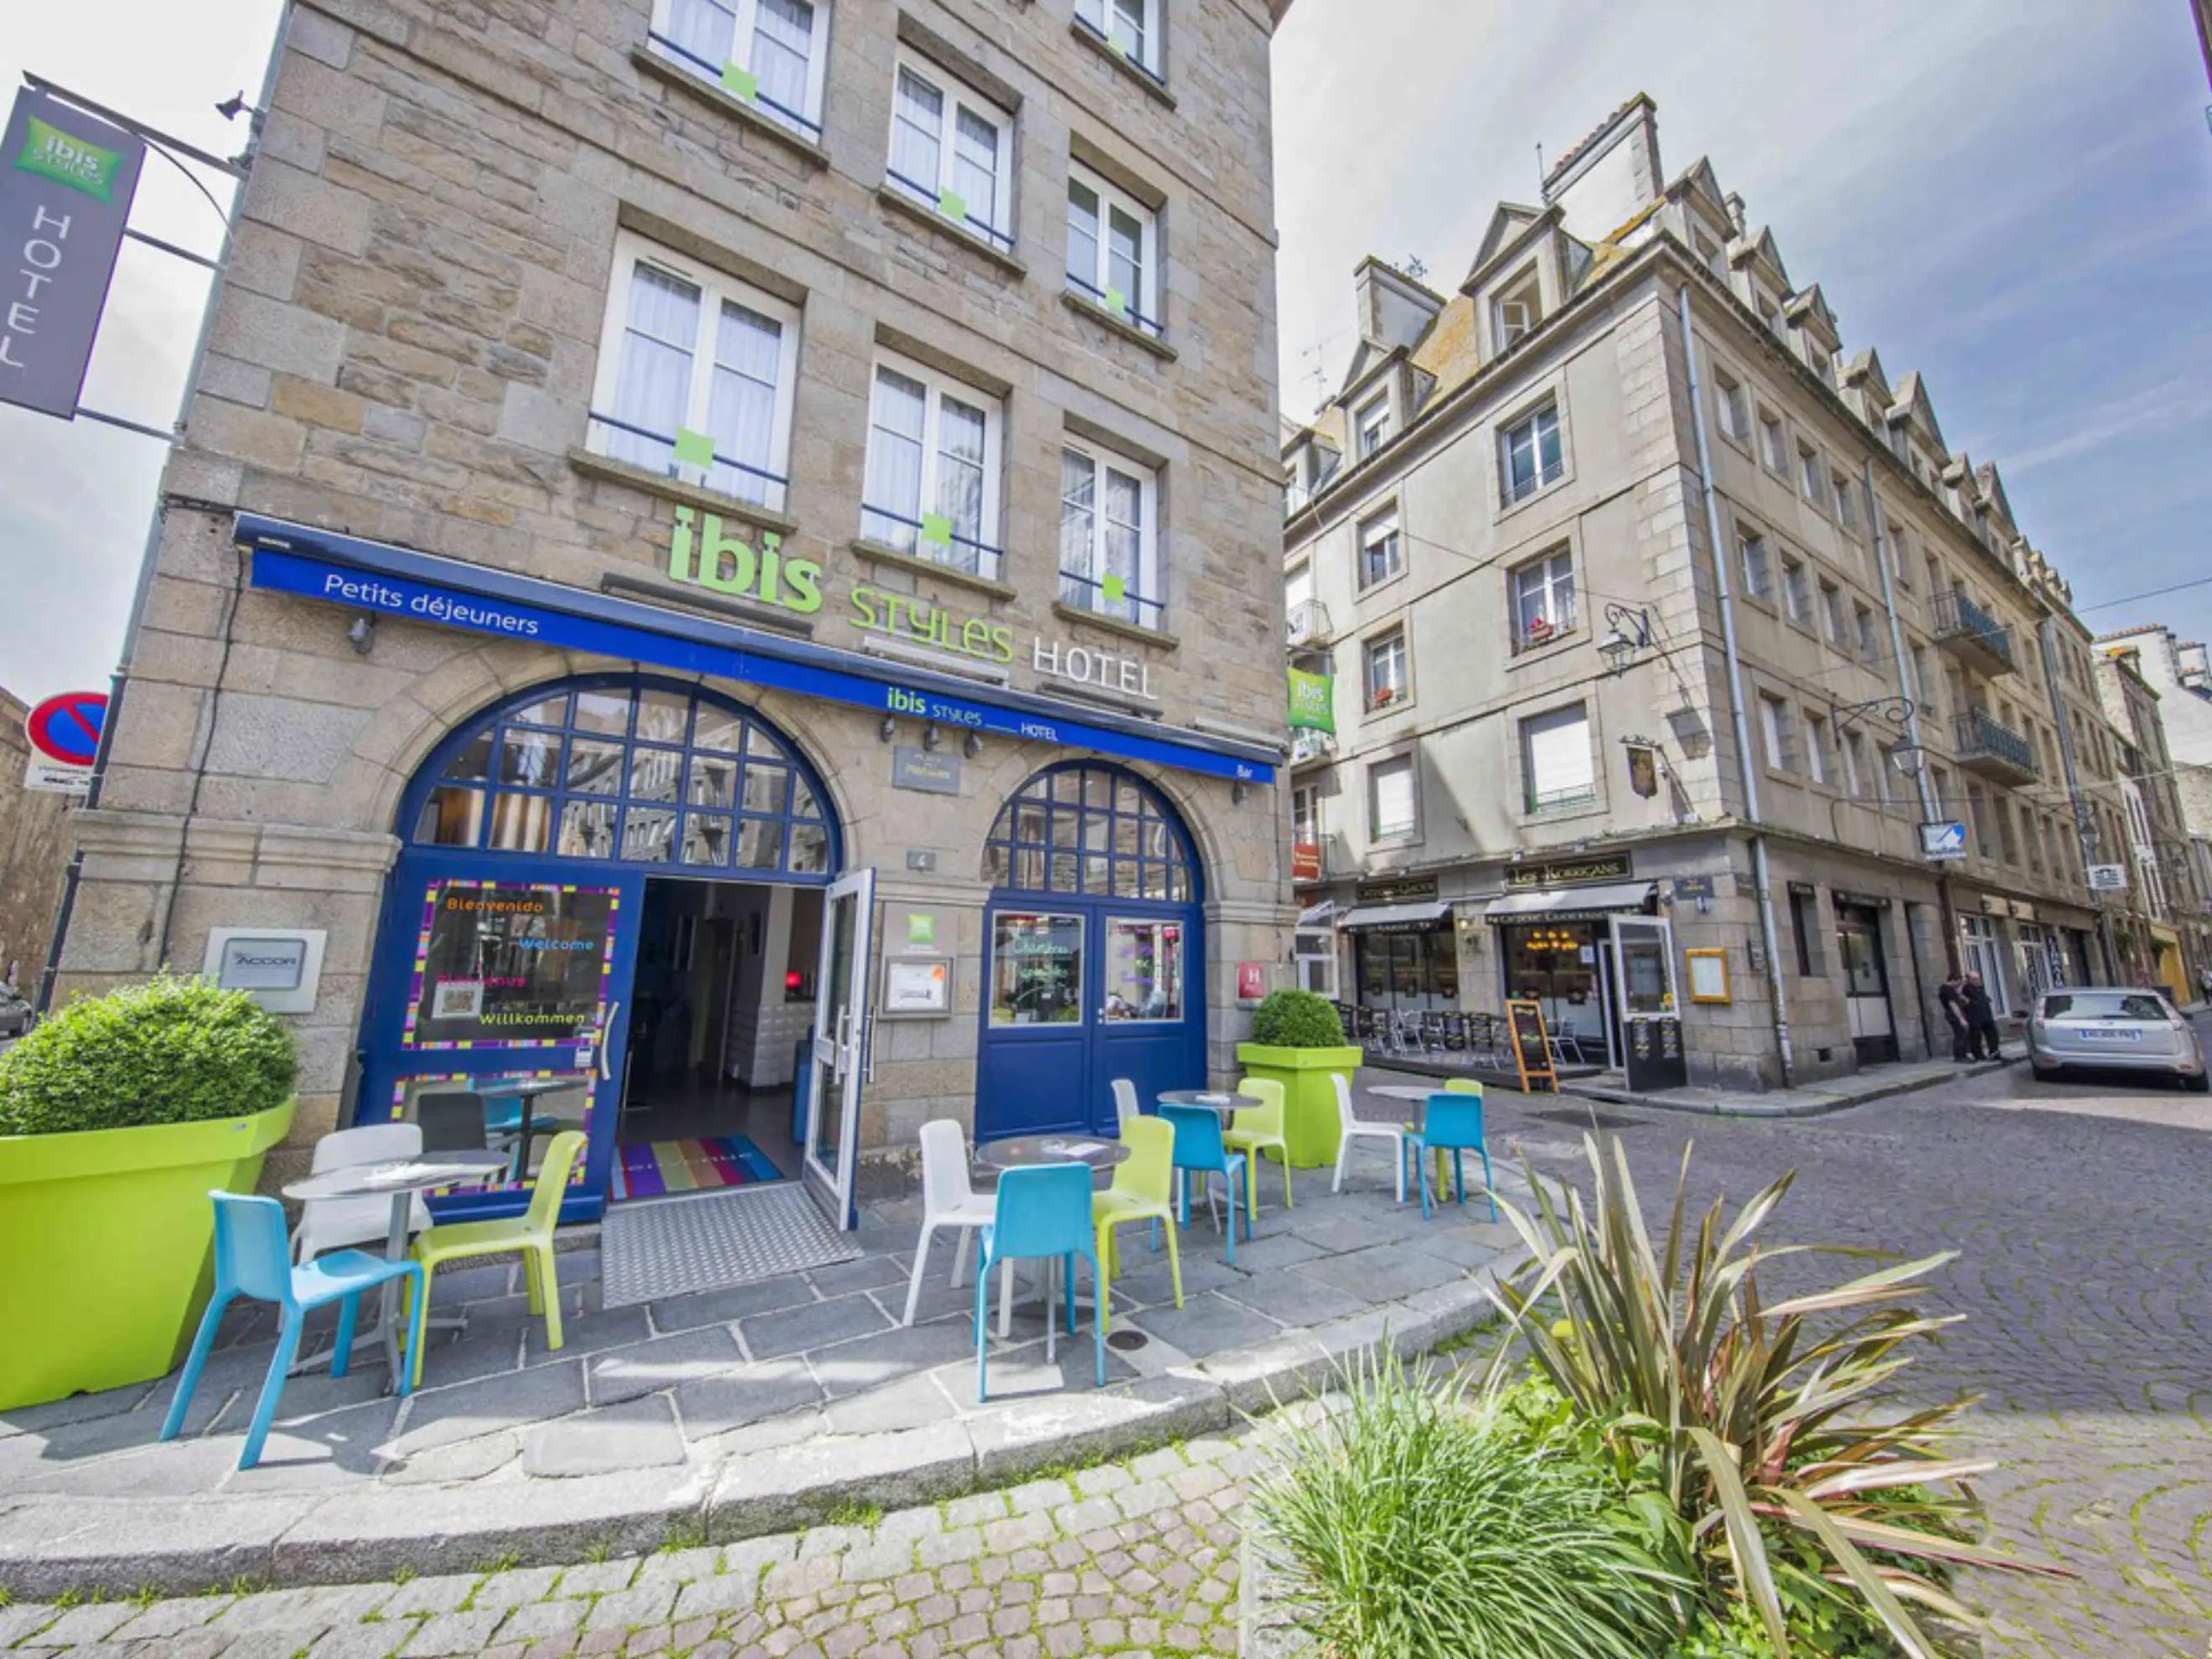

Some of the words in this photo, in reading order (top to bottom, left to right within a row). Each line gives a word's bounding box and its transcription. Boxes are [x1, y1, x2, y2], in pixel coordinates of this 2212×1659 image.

[45, 135, 99, 171] ibis
[0, 205, 70, 368] HOTEL
[324, 573, 404, 607] Petits
[410, 593, 539, 635] déjeuners
[669, 504, 822, 613] ibis
[1033, 635, 1160, 700] HOTEL
[886, 686, 927, 714] ibis
[1021, 721, 1059, 742] HOTEL
[446, 897, 544, 913] Bienvenido
[518, 937, 595, 950] Welcome
[479, 1011, 586, 1026] Willkommen
